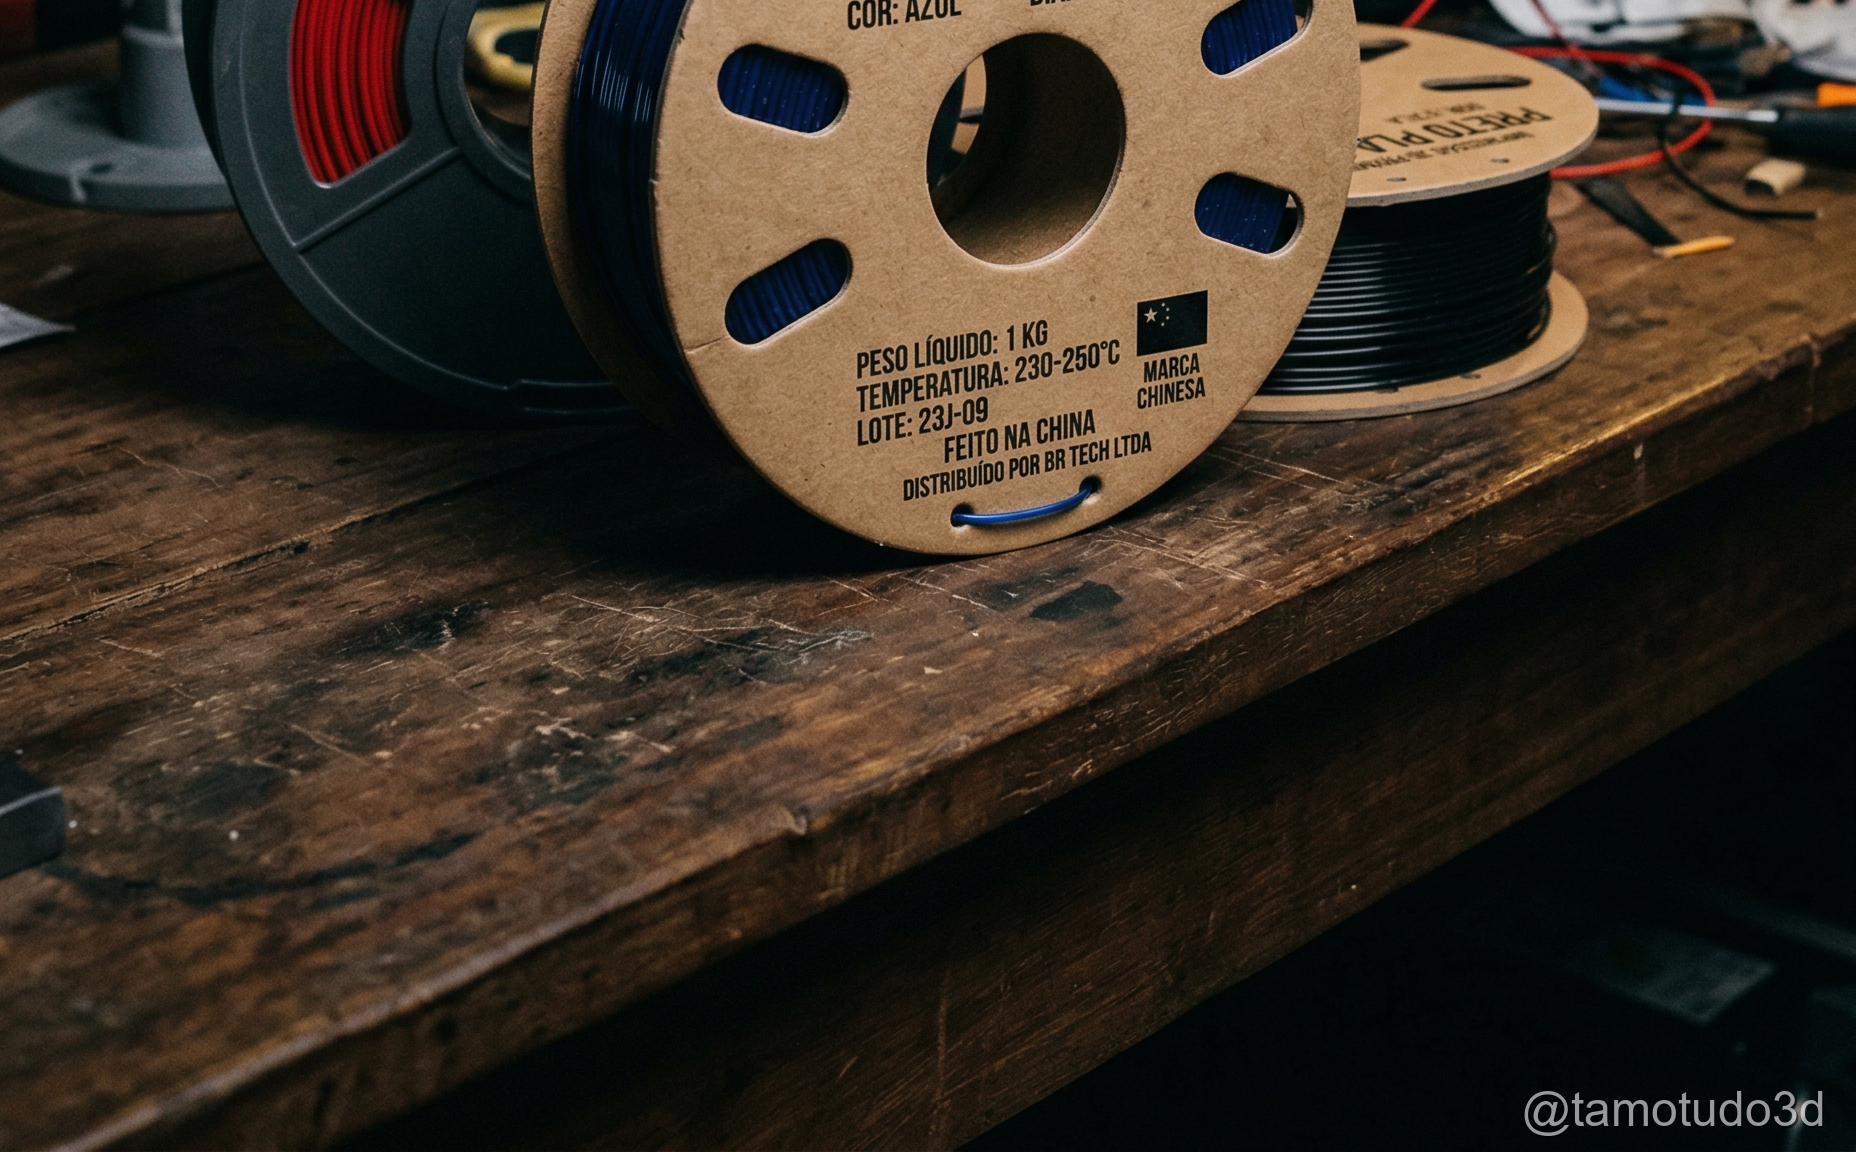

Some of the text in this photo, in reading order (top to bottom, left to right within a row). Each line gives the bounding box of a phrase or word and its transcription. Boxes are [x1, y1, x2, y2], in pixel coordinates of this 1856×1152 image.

[1421, 106, 1553, 139] PRETO
[856, 319, 1048, 379] PESO LÍQUIDO: 1 KG
[1143, 352, 1200, 383] MARCA
[856, 339, 1120, 412] TEMPERATURA: 230-250°C
[1137, 376, 1206, 409] CHINESA
[857, 396, 989, 447] LOTE: 23J-09
[944, 409, 1096, 463] FEITO NA CHINA
[903, 431, 1152, 501] DISTRIBUÍDO POR BR TECH LTDA
